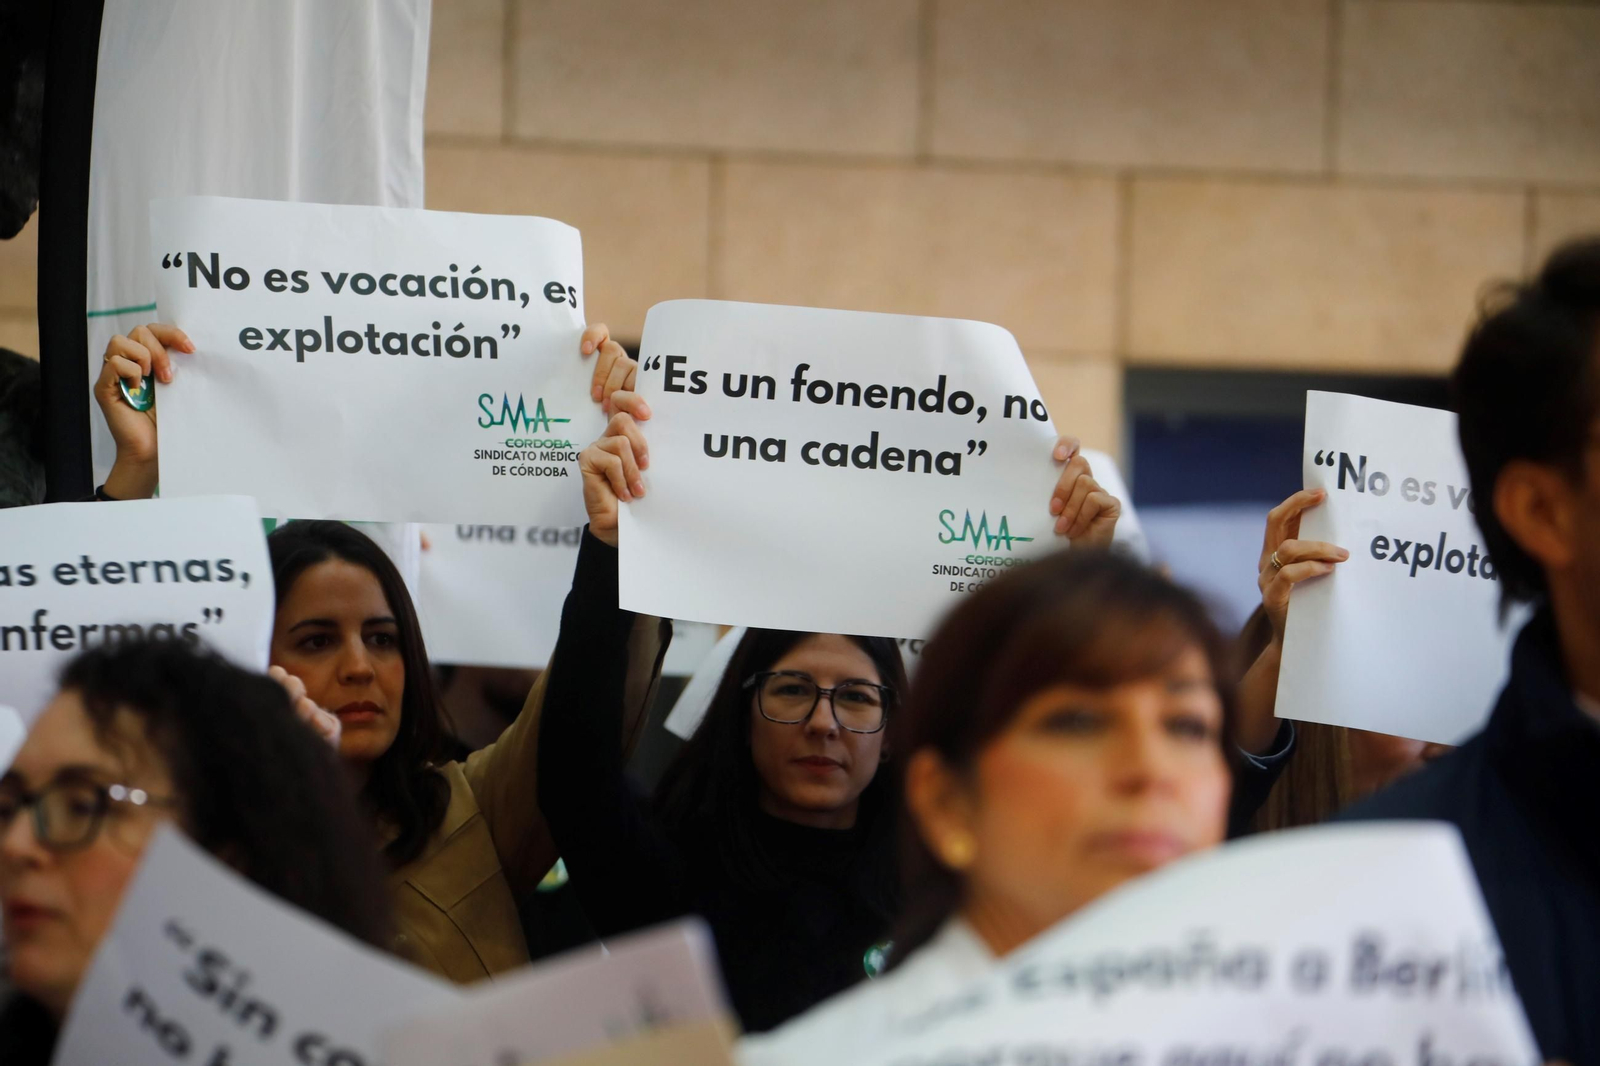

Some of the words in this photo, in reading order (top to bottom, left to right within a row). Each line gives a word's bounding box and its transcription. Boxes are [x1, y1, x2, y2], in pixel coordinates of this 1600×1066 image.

[162, 251, 250, 291] “No
[263, 267, 310, 294] es
[321, 263, 531, 309] vocación,
[543, 279, 578, 309] es
[238, 315, 521, 363] explotación”
[643, 354, 708, 395] “Es
[721, 371, 777, 400] un
[790, 362, 988, 424] fonendo,
[1002, 393, 1050, 422] no
[478, 391, 571, 434] SMA
[474, 449, 536, 461] SINDICATO
[504, 438, 573, 449] CORDOBA
[702, 432, 787, 463] una
[800, 430, 988, 476] cadena”
[493, 465, 506, 476] DE
[510, 463, 568, 477] CÓRDOBA
[1314, 449, 1390, 497] “No
[1400, 476, 1437, 506] es
[456, 524, 516, 544] una
[938, 507, 1035, 552] SMA
[53, 554, 252, 589] eternas,
[932, 564, 997, 579] SINDICATO
[950, 581, 965, 593] DE
